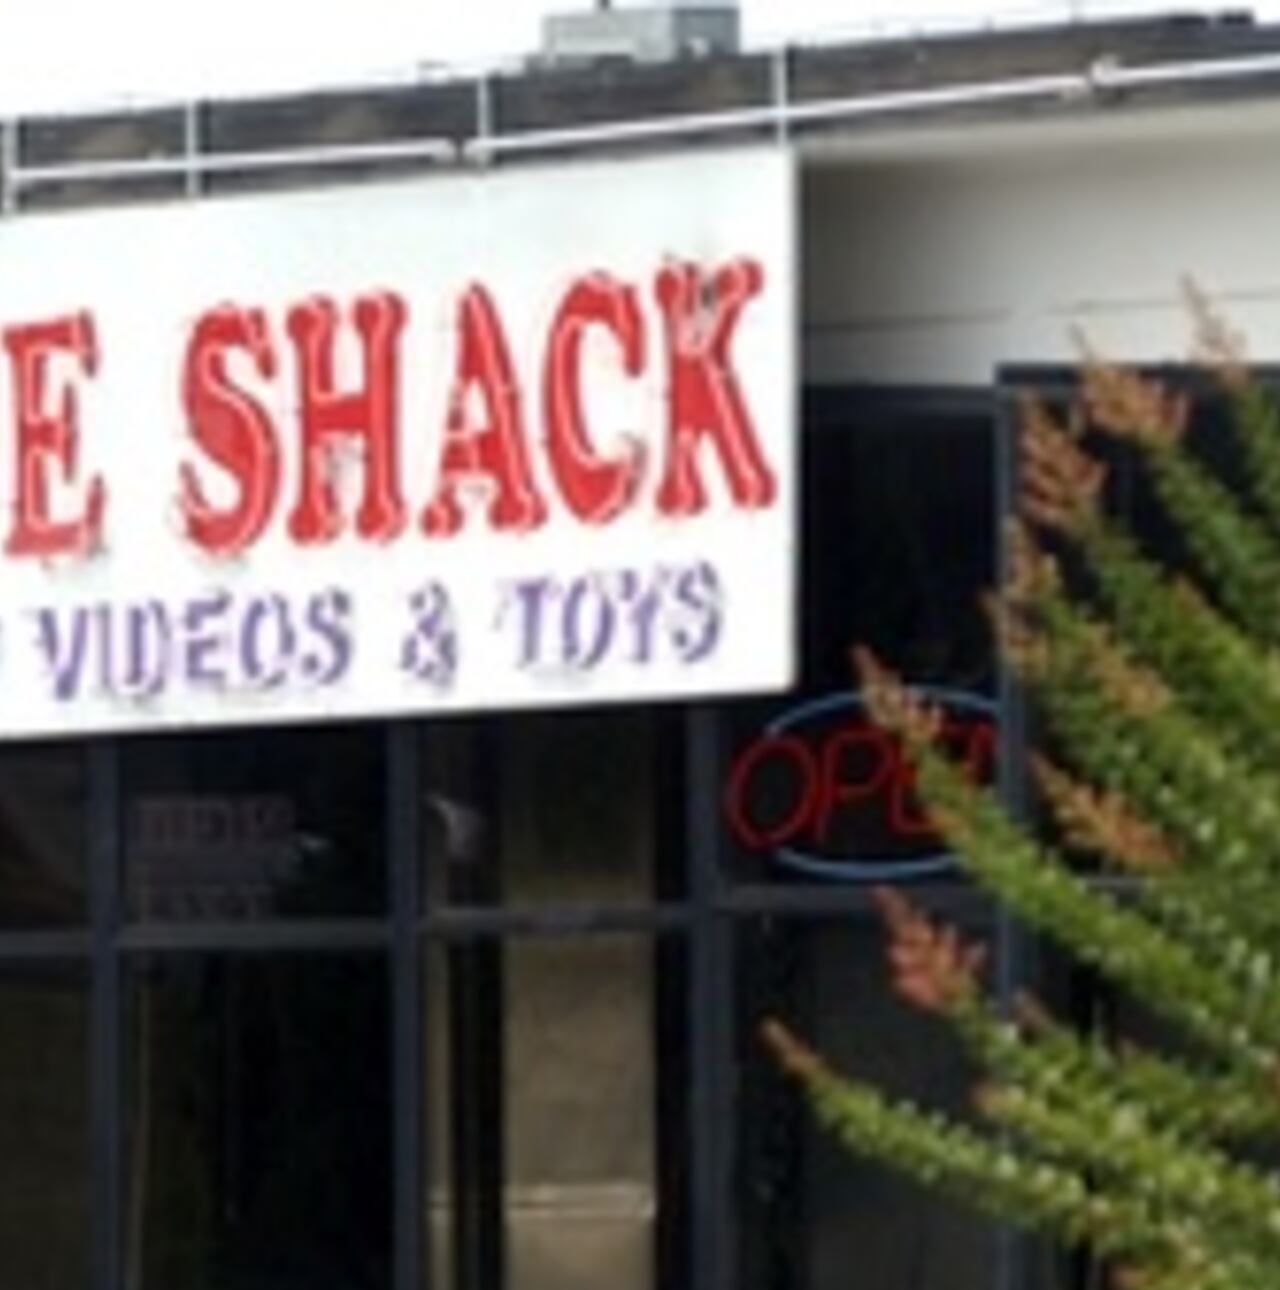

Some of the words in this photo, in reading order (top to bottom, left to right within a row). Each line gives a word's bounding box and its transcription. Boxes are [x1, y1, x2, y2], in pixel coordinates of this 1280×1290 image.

[177, 256, 776, 560] SHACK
[38, 588, 354, 702] VIDEOS
[401, 580, 458, 690] &
[508, 560, 722, 672] TOYS
[725, 718, 996, 852] OPE
